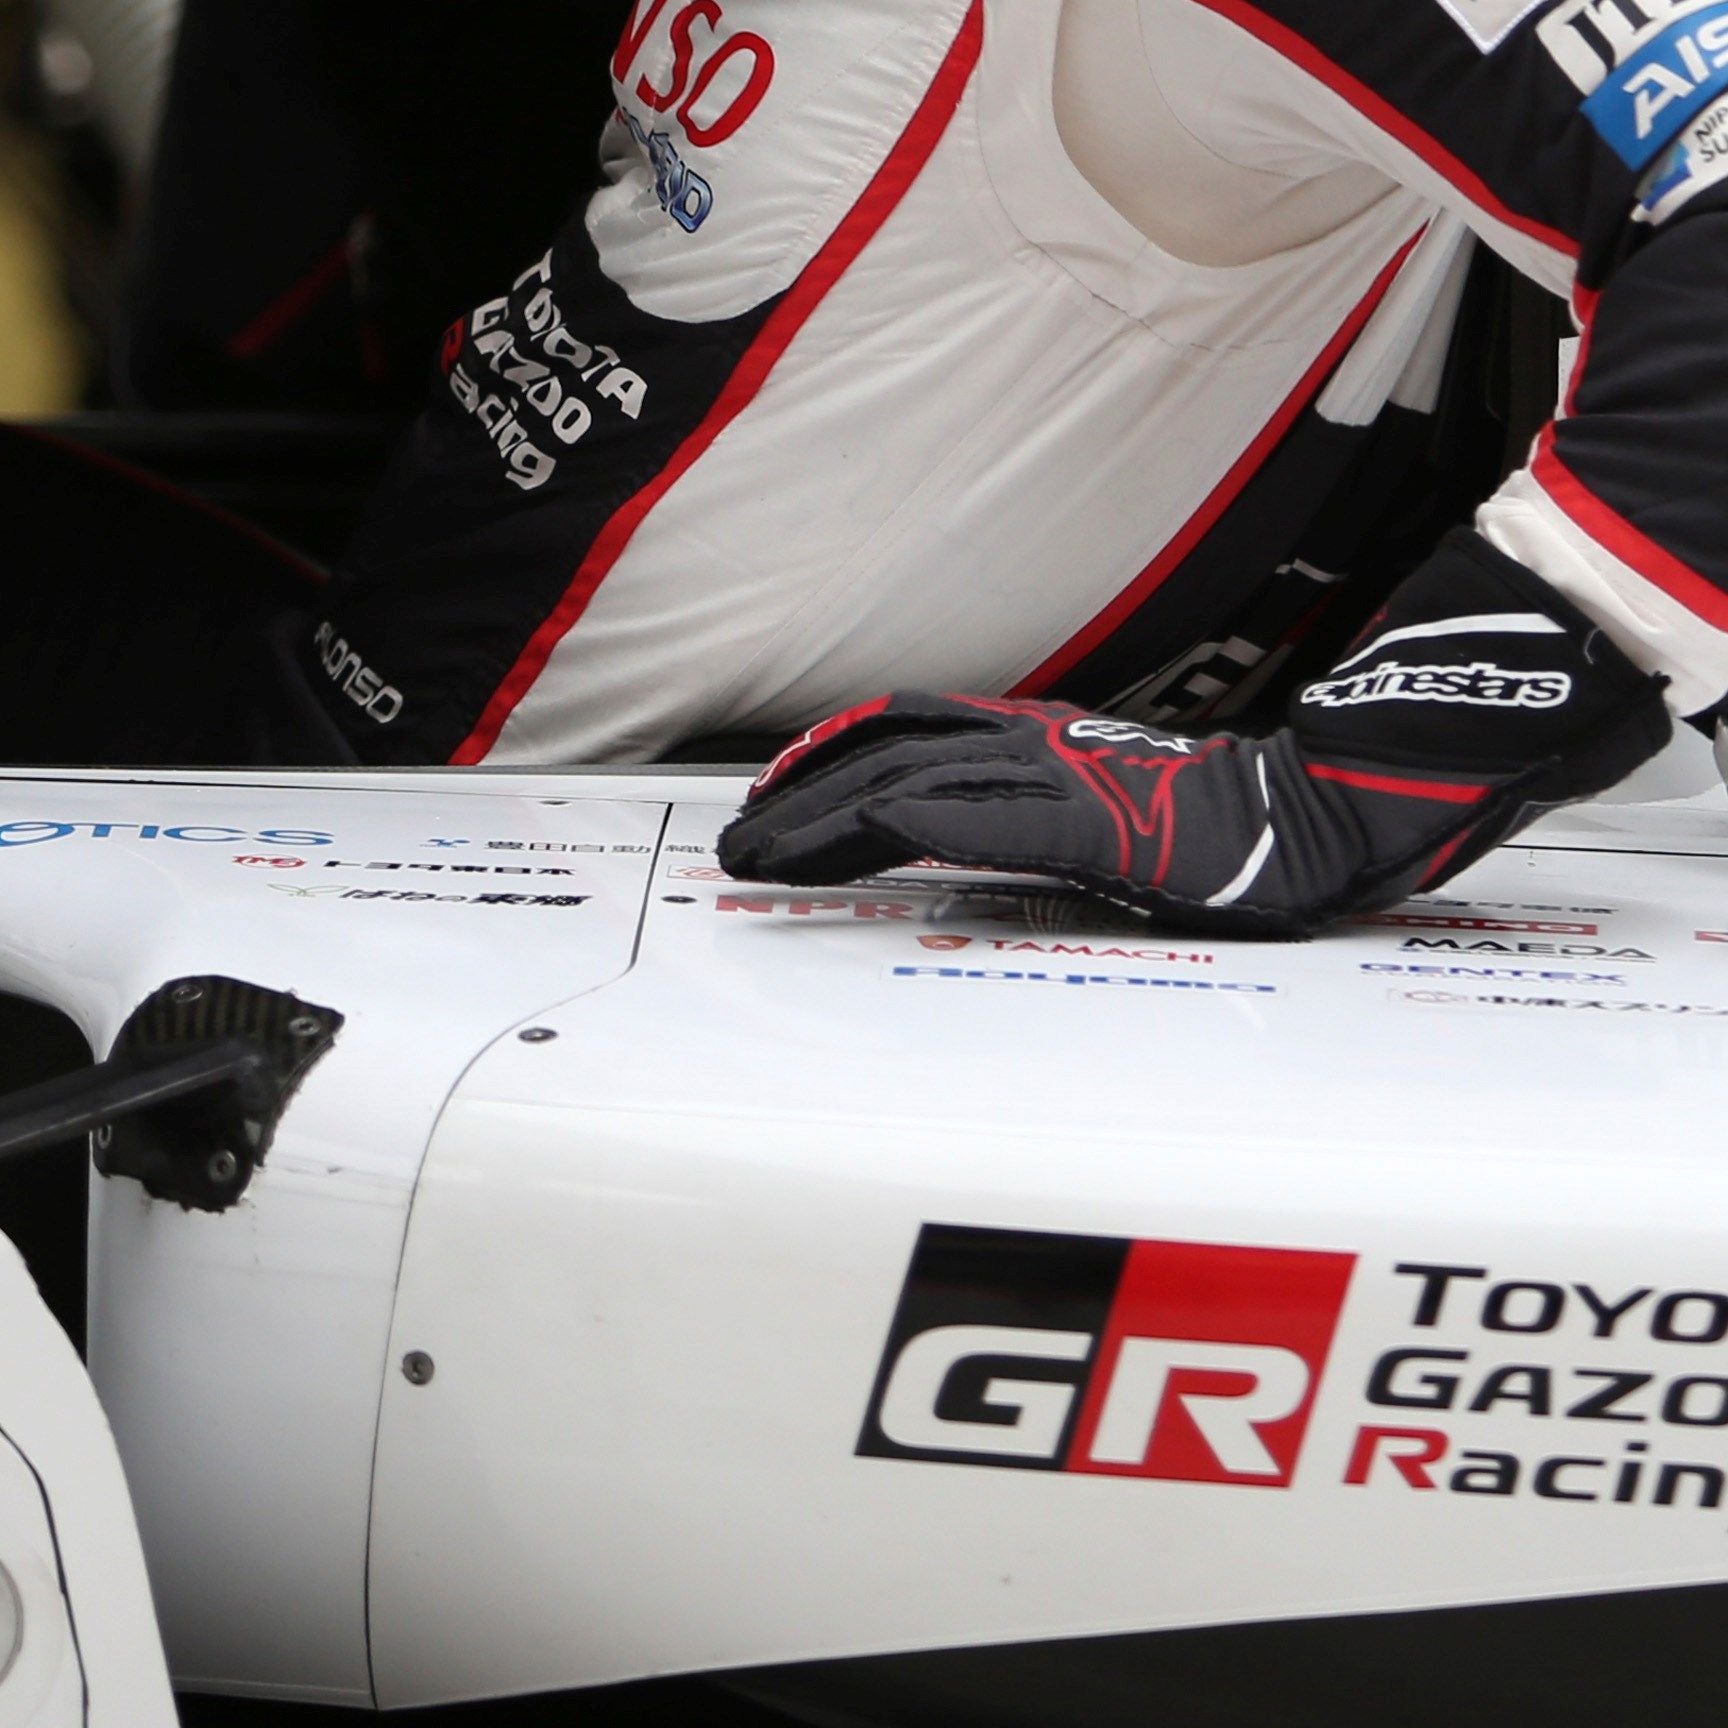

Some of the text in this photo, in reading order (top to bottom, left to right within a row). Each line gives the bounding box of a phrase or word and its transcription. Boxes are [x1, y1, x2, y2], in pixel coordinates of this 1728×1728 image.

[513, 247, 647, 420] TOYOTA
[472, 296, 591, 444] GAZOO
[441, 317, 557, 491] Racing
[314, 622, 403, 724] ALONSO
[485, 839, 715, 855] 豊田自動織
[716, 894, 912, 920] NPR
[1406, 918, 1584, 932] HINO
[986, 939, 1218, 964] TAMACHI
[1403, 937, 1654, 960] MAEDA
[1360, 963, 1625, 982] GENTEX
[872, 1312, 1316, 1480] GR
